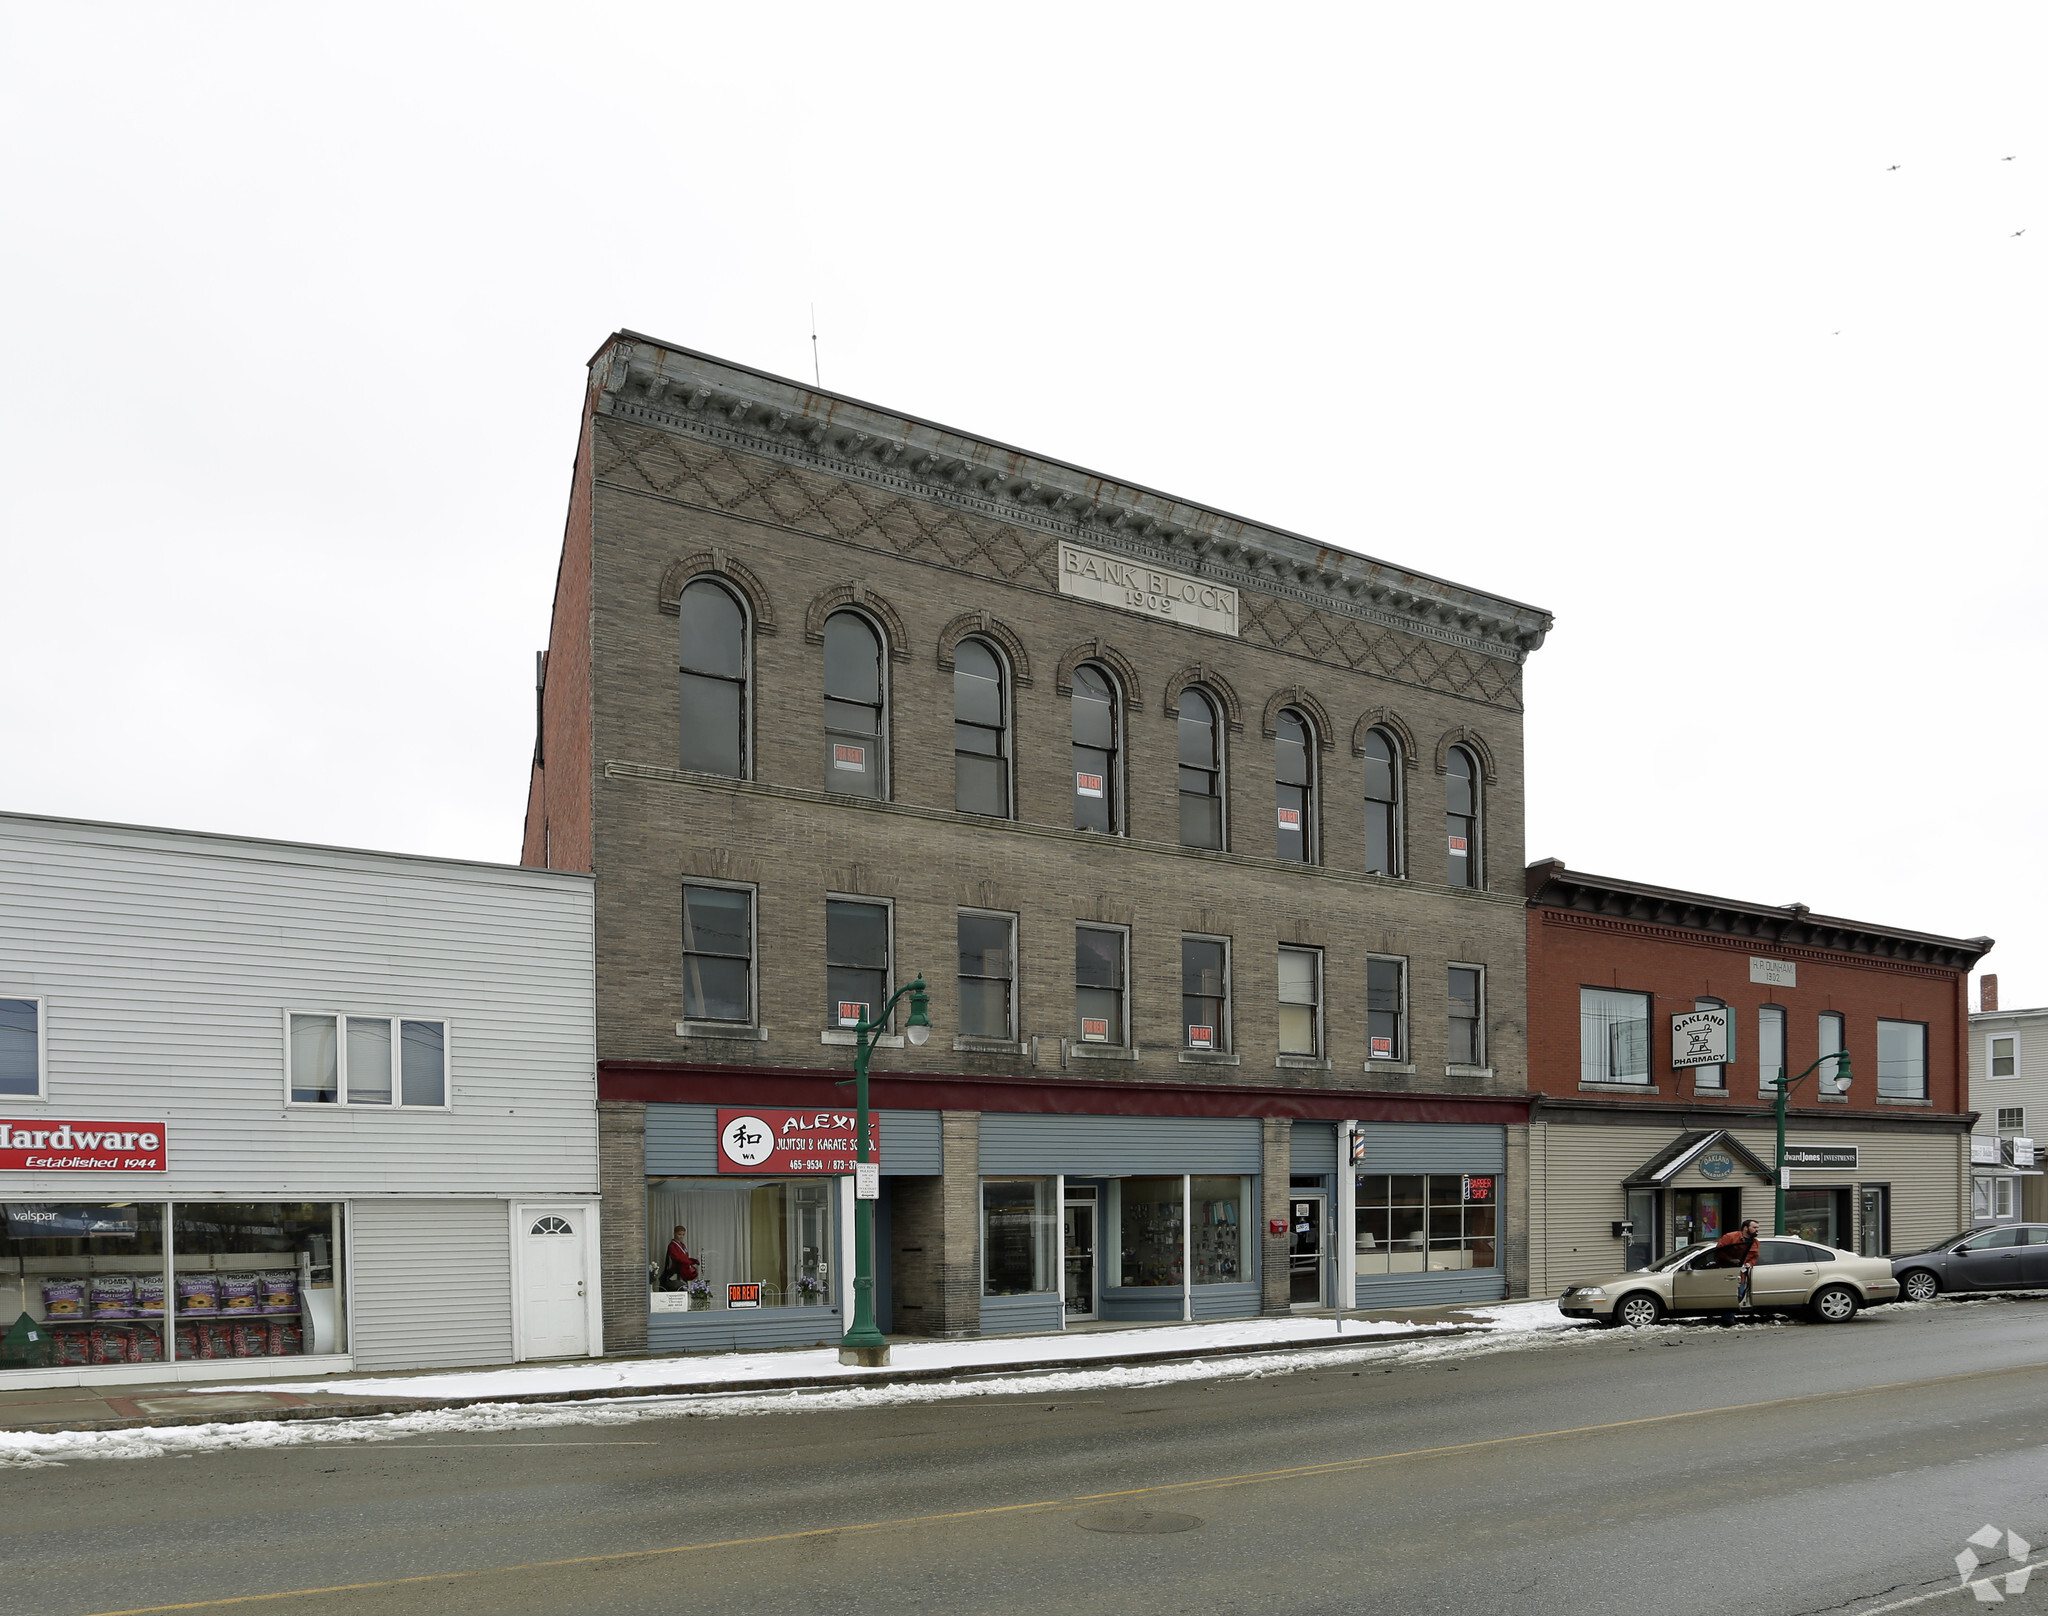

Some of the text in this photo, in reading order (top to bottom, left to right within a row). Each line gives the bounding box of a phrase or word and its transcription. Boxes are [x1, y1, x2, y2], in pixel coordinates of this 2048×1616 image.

[1064, 550, 1233, 614] BANK BLOCK
[1125, 589, 1173, 614] 1902
[1674, 1014, 1725, 1031] OAKLAND
[1674, 1053, 1725, 1065] PHARMACY
[732, 1124, 763, 1149] 和
[776, 1138, 877, 1152] JUJITSU & KARATE SCOL
[25, 1156, 157, 1168] Established 1944
[789, 1160, 823, 1170] 465-9534
[832, 1160, 857, 1170] 873-37
[1703, 1155, 1730, 1165] OAKLAND
[1470, 1179, 1492, 1188] BARBER
[1472, 1189, 1488, 1199] SHOP
[13, 1210, 58, 1223] valspar
[729, 1285, 759, 1300] FOR RENT
